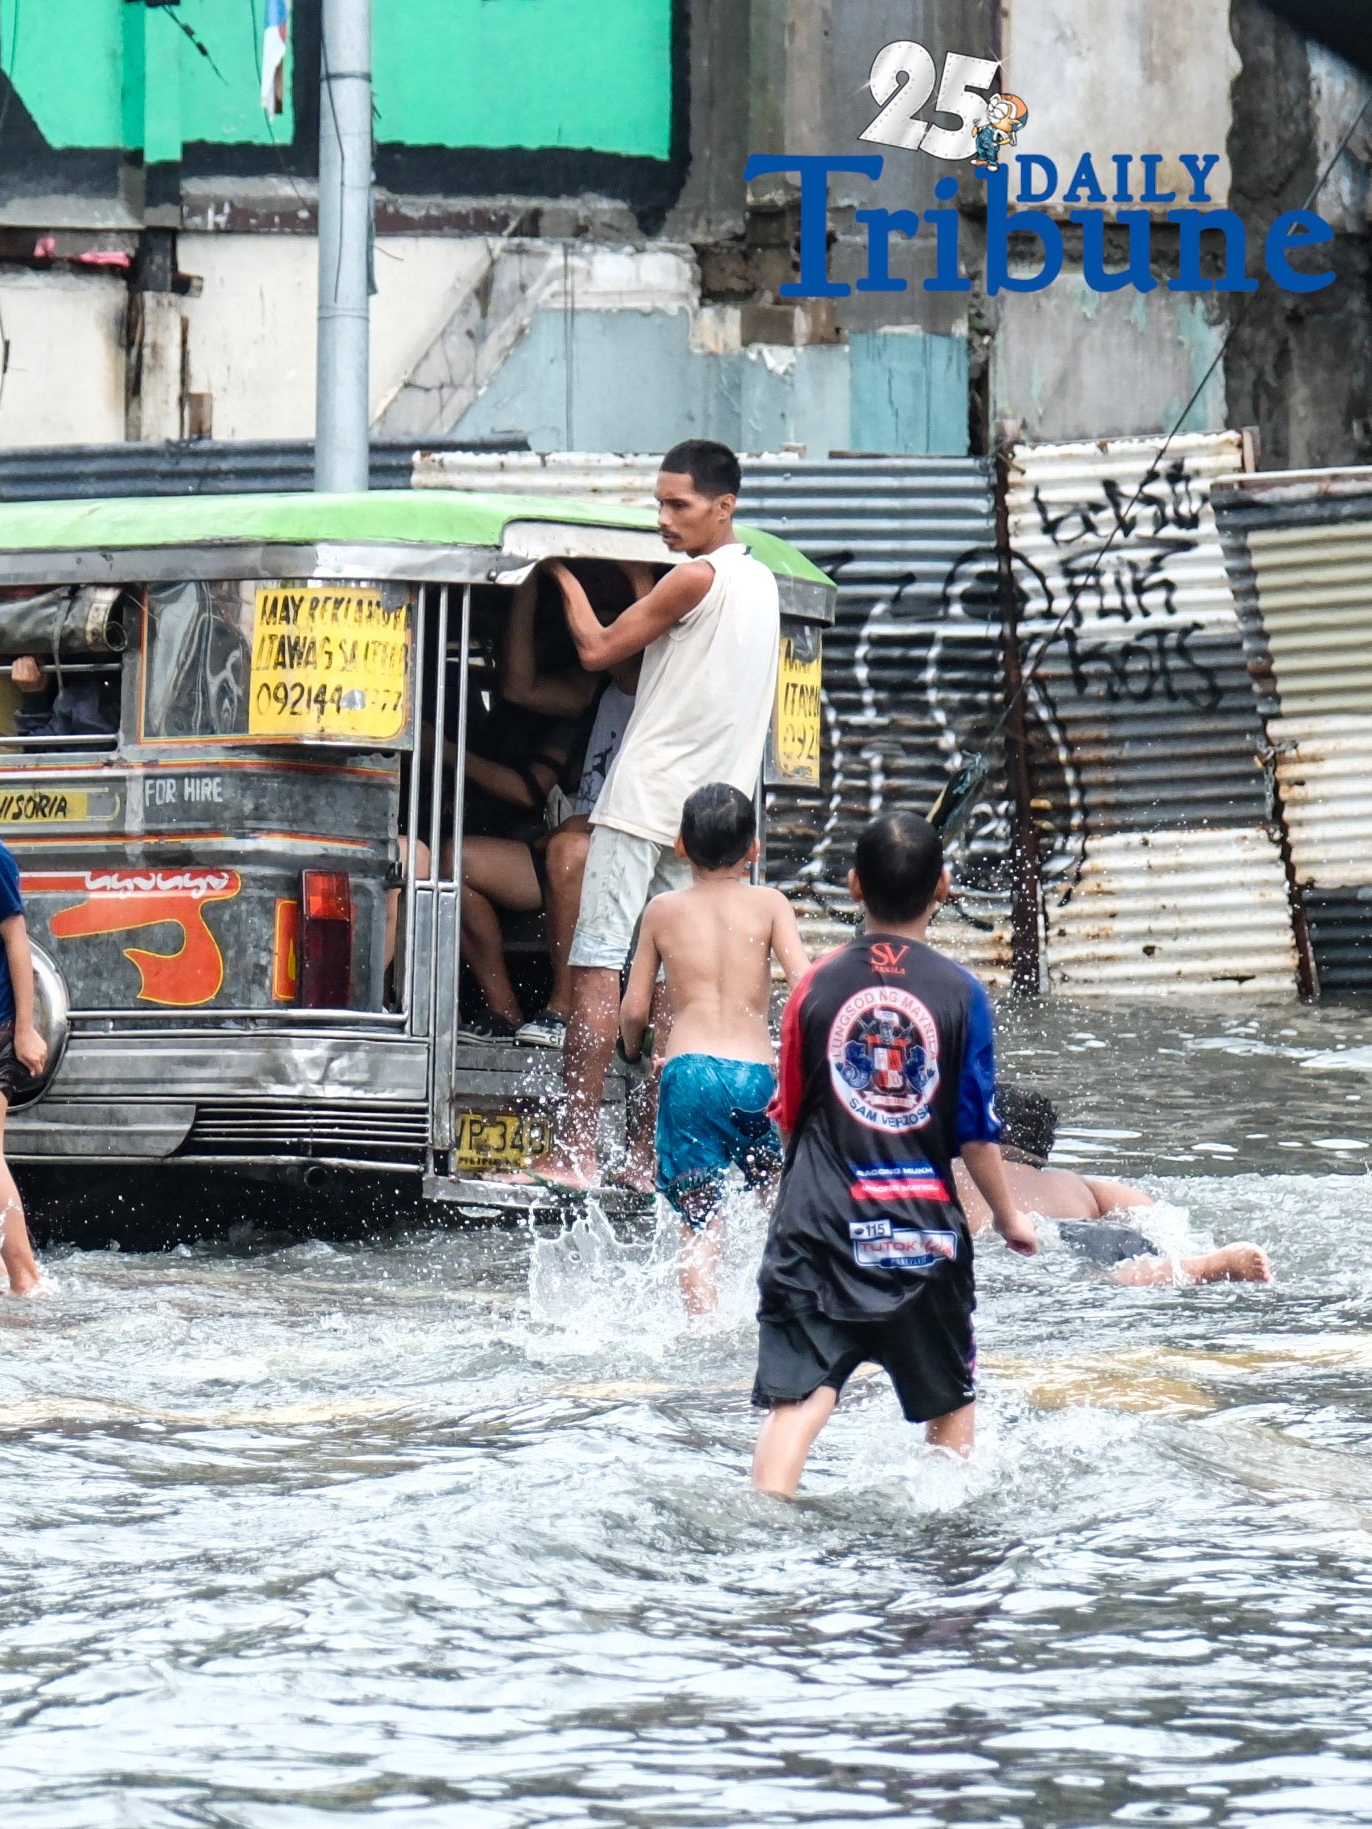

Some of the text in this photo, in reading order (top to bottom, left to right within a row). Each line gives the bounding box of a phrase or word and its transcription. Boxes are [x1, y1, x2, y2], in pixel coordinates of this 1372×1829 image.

[260, 594, 305, 627] MAY
[143, 777, 223, 807] FOR HIRE
[870, 942, 910, 966] SV
[831, 992, 875, 1058] LUNGSOD
[879, 989, 899, 1003] NG
[849, 1097, 878, 1122] SAM
[865, 1223, 886, 1237] 115
